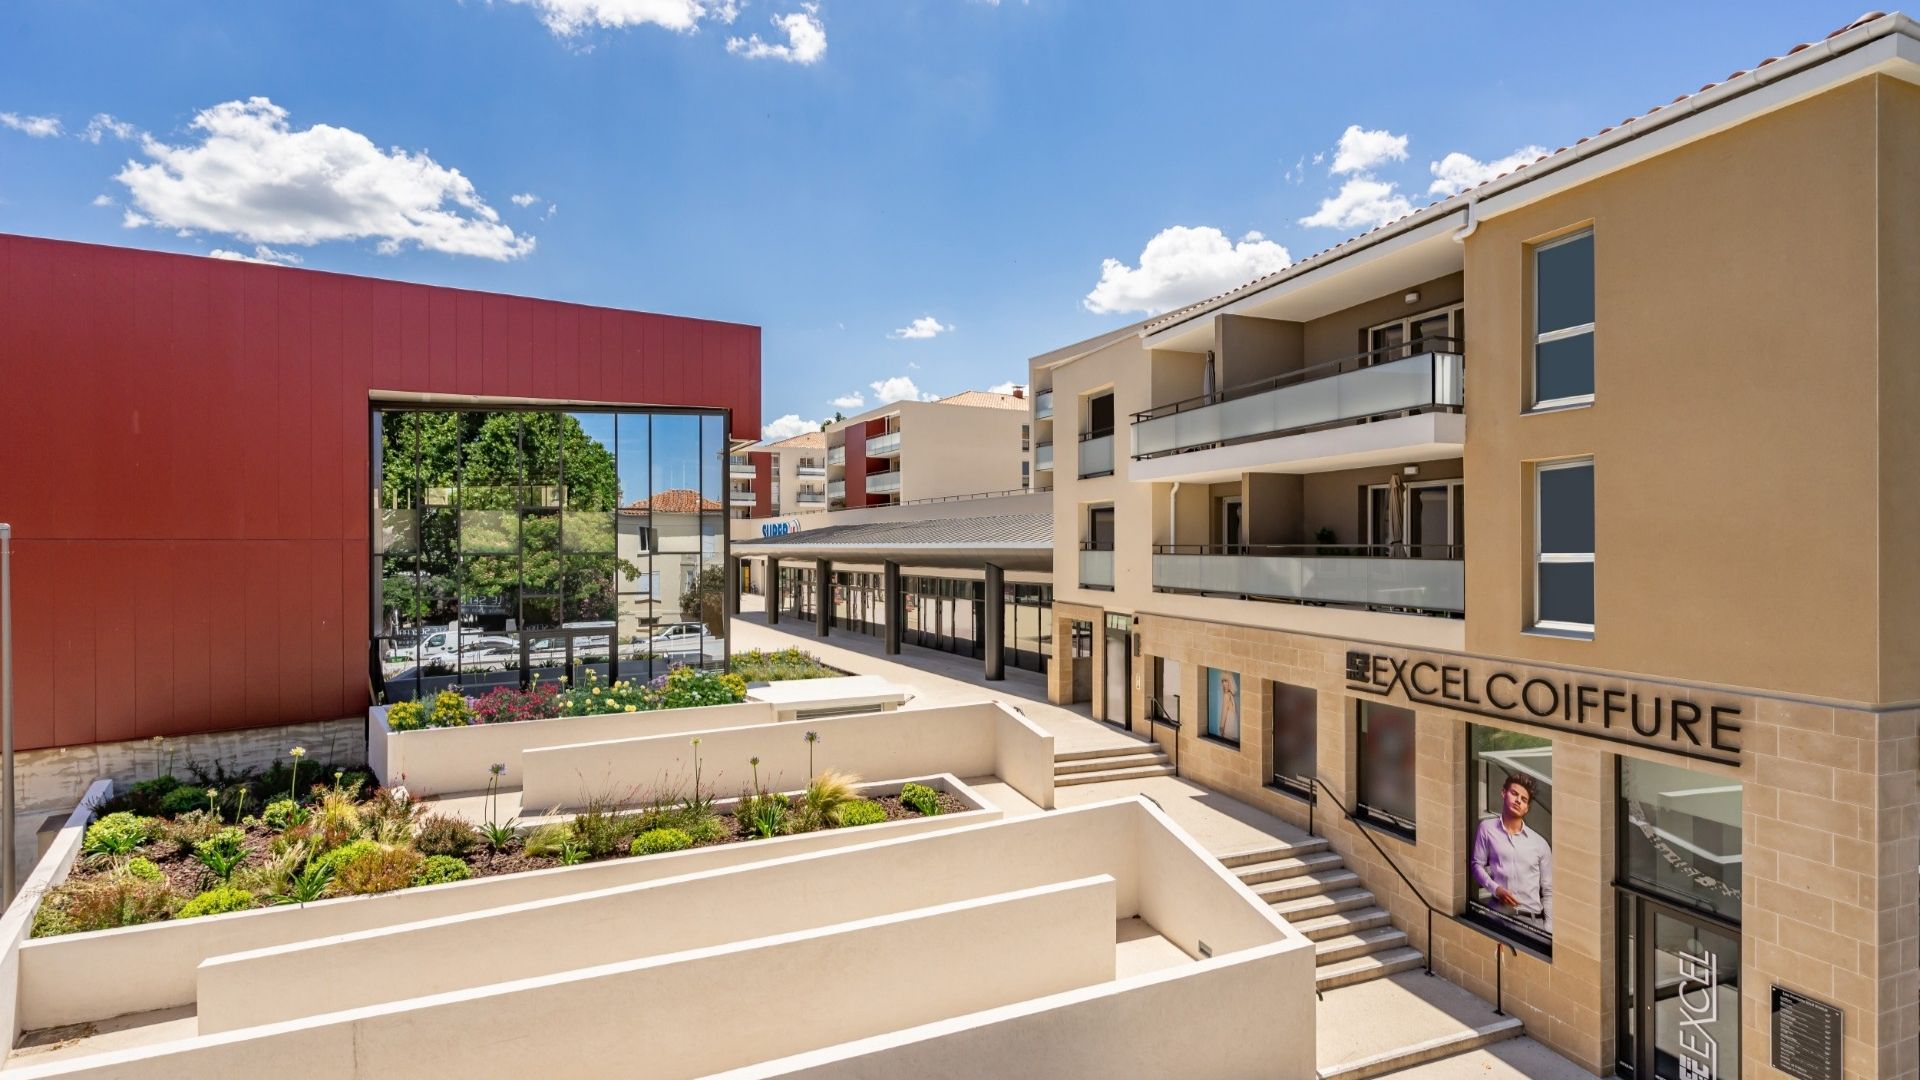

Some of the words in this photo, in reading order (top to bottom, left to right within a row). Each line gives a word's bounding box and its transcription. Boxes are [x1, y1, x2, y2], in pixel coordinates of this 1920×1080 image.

[1372, 656, 1481, 704] EXCEL
[1485, 673, 1741, 754] COIFFURE
[1679, 949, 1716, 1059] EXCEL
